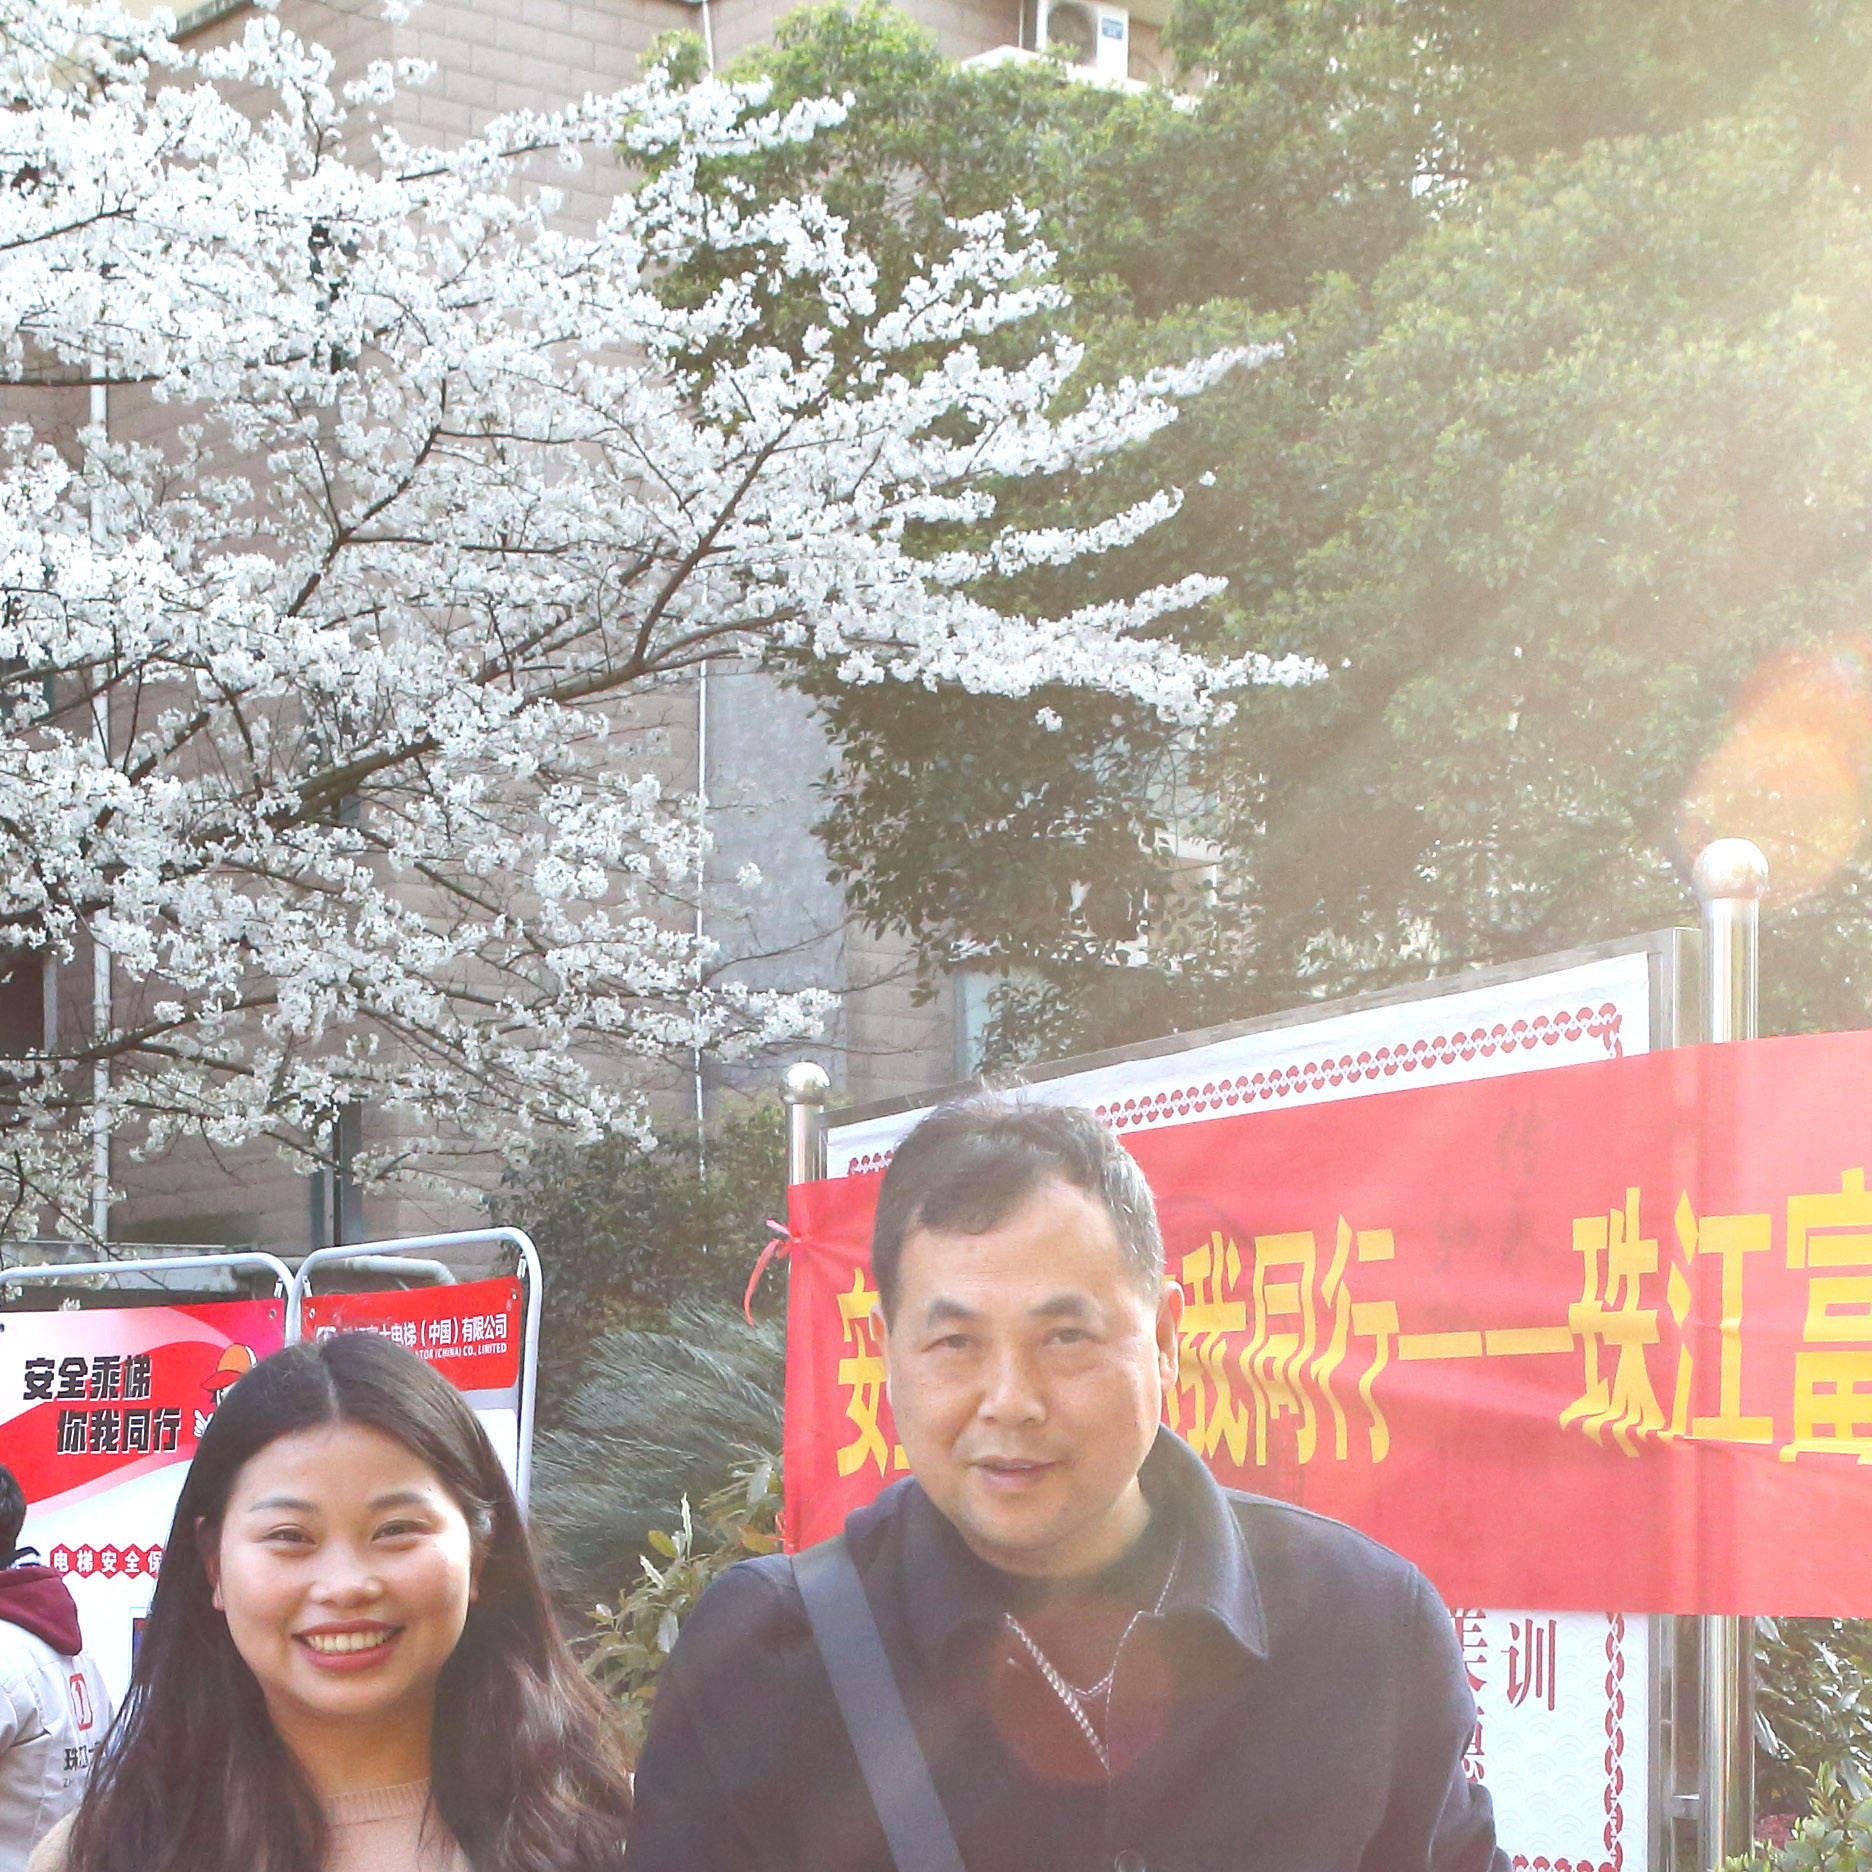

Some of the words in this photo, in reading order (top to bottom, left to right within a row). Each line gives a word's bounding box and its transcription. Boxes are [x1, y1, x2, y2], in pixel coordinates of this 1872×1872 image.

[343, 1313, 507, 1347] 士电梯（中国）有限公司
[478, 1342, 507, 1356] LIMITED
[23, 1355, 152, 1401] 安全乘梯
[57, 1407, 182, 1455] 你我同行
